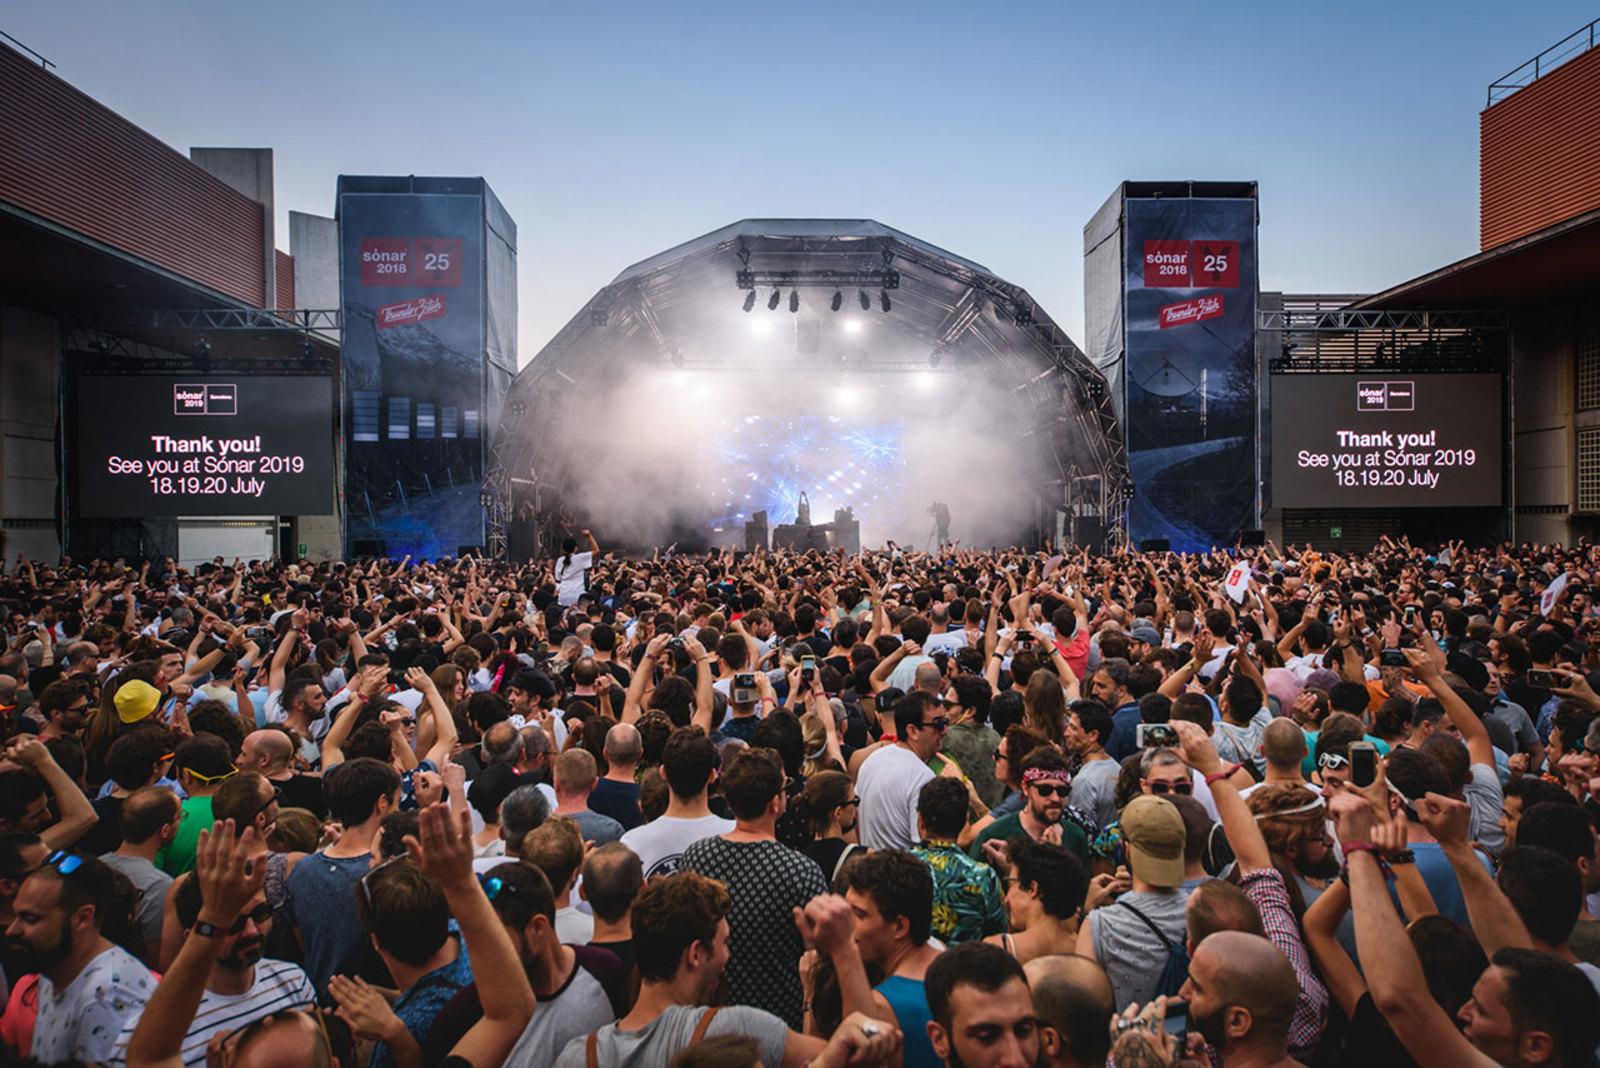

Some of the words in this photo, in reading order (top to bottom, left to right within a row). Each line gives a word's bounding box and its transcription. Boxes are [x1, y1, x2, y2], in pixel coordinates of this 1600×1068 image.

[377, 263, 407, 274] 2018
[424, 253, 450, 271] 25
[1159, 265, 1188, 276] 2018
[1203, 255, 1228, 272] 25
[151, 435, 214, 453] Thank
[218, 435, 261, 456] you!
[1337, 430, 1393, 447] Thank
[1397, 430, 1436, 450] you!
[108, 456, 143, 473] See
[147, 460, 178, 477] you
[183, 458, 200, 473] at
[204, 455, 256, 474] Sónar
[260, 456, 305, 473] 2019
[1298, 450, 1329, 467] See
[1332, 454, 1362, 470] you
[1365, 451, 1380, 466] at
[1384, 450, 1431, 467] Sónar
[1435, 450, 1476, 466] 2019
[150, 477, 227, 495] 18.19.20
[231, 477, 266, 497] July
[1335, 469, 1405, 486] 18.19.20
[1408, 469, 1440, 489] July
